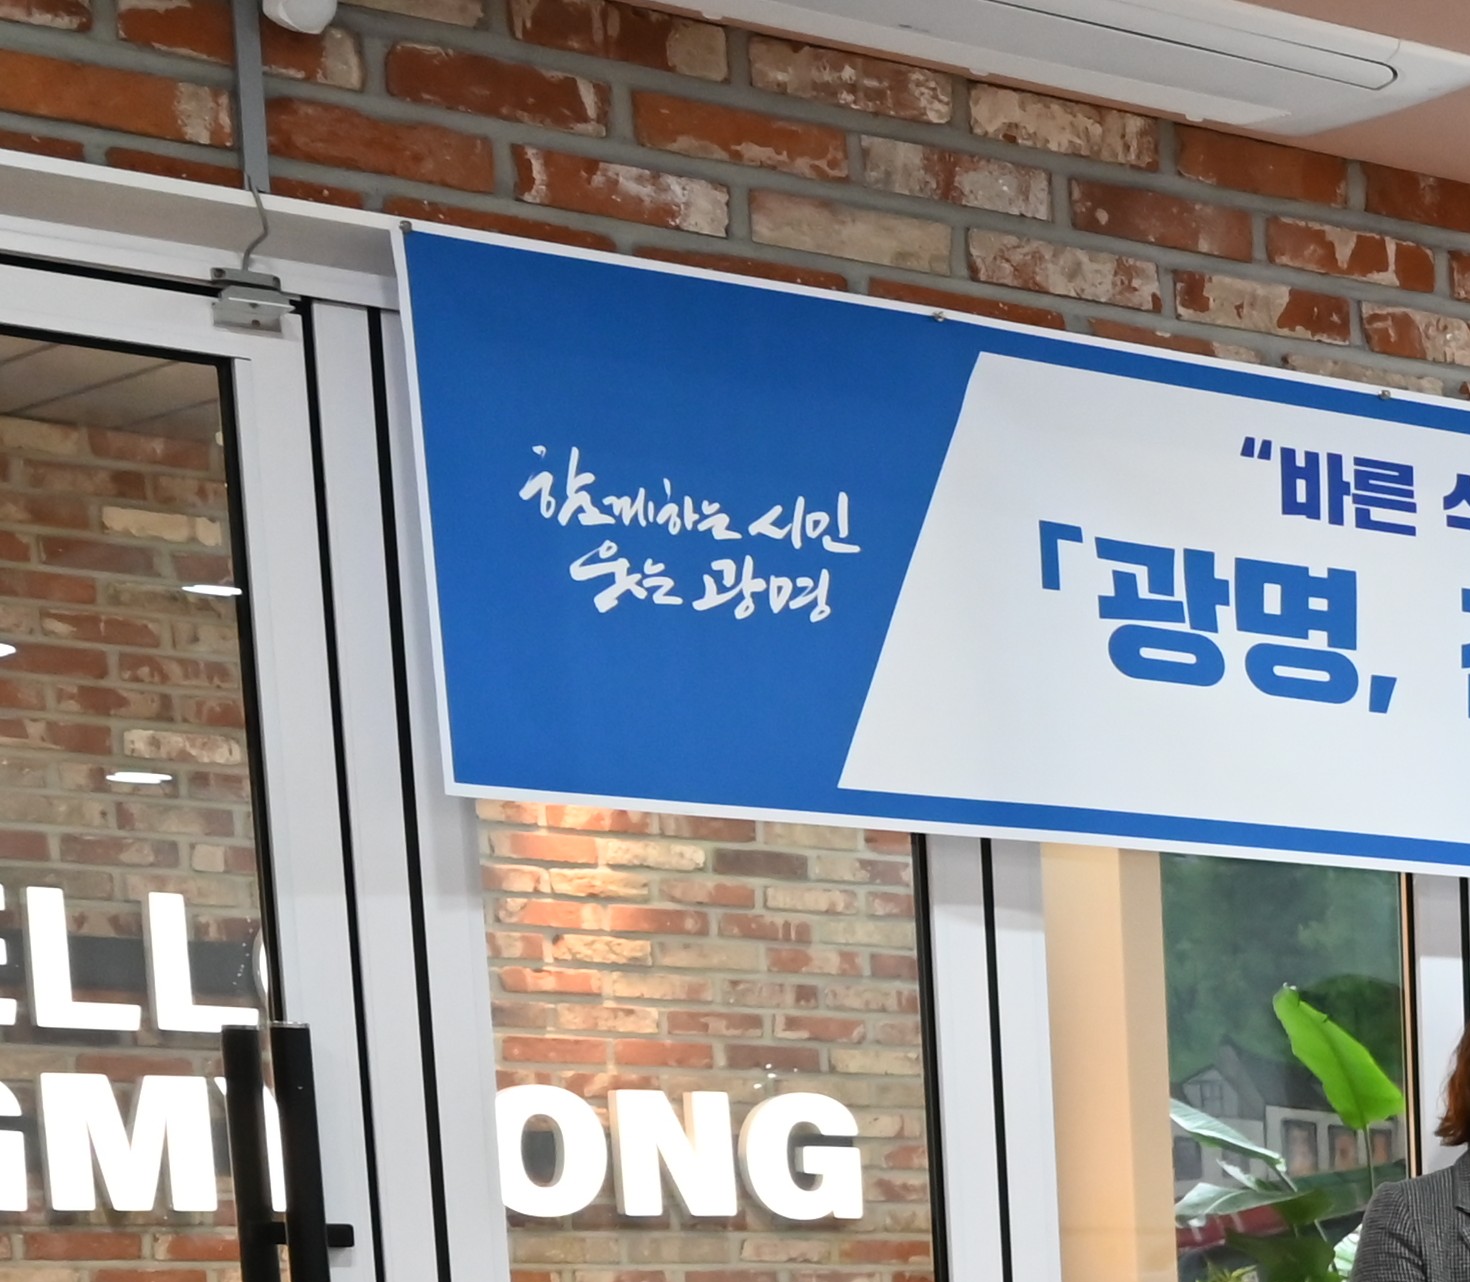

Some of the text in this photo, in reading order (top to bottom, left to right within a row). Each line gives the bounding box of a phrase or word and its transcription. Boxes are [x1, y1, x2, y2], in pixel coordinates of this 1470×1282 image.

[519, 445, 862, 554] 함께하는 시민
[691, 554, 832, 623] 광명
